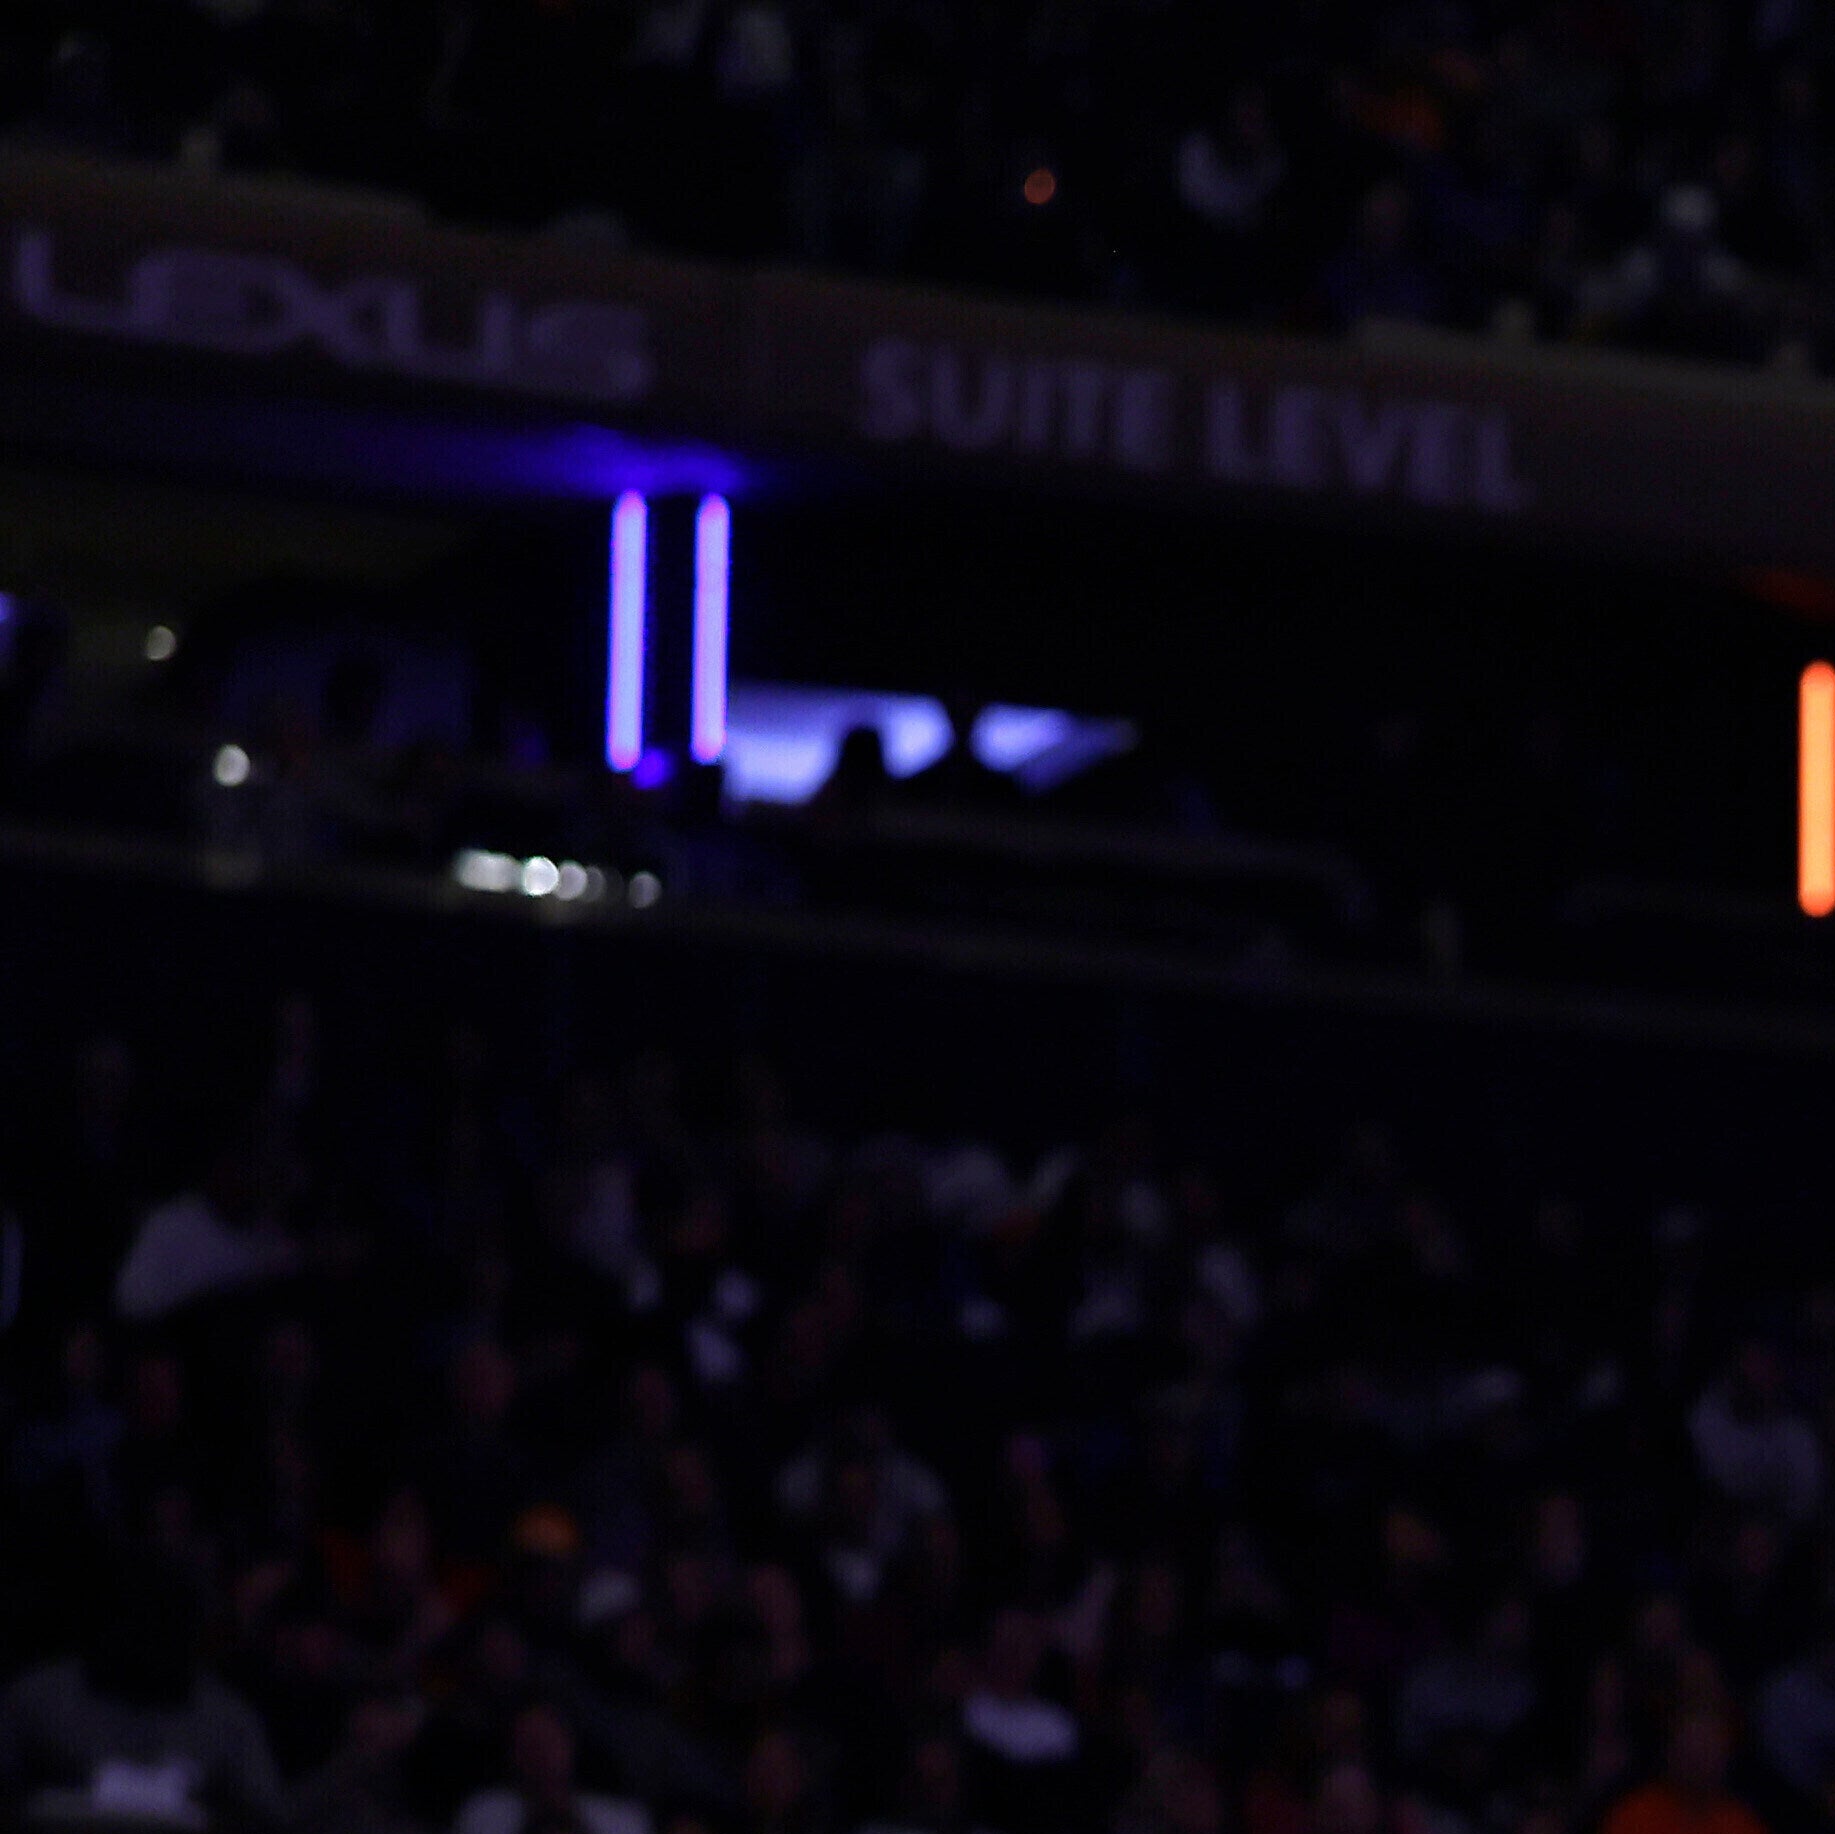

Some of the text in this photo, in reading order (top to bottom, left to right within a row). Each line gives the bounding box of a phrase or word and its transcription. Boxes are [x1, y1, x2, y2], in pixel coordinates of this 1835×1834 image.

[12, 232, 655, 402] LEXUS
[858, 338, 1534, 512] SUITE LEVEL
